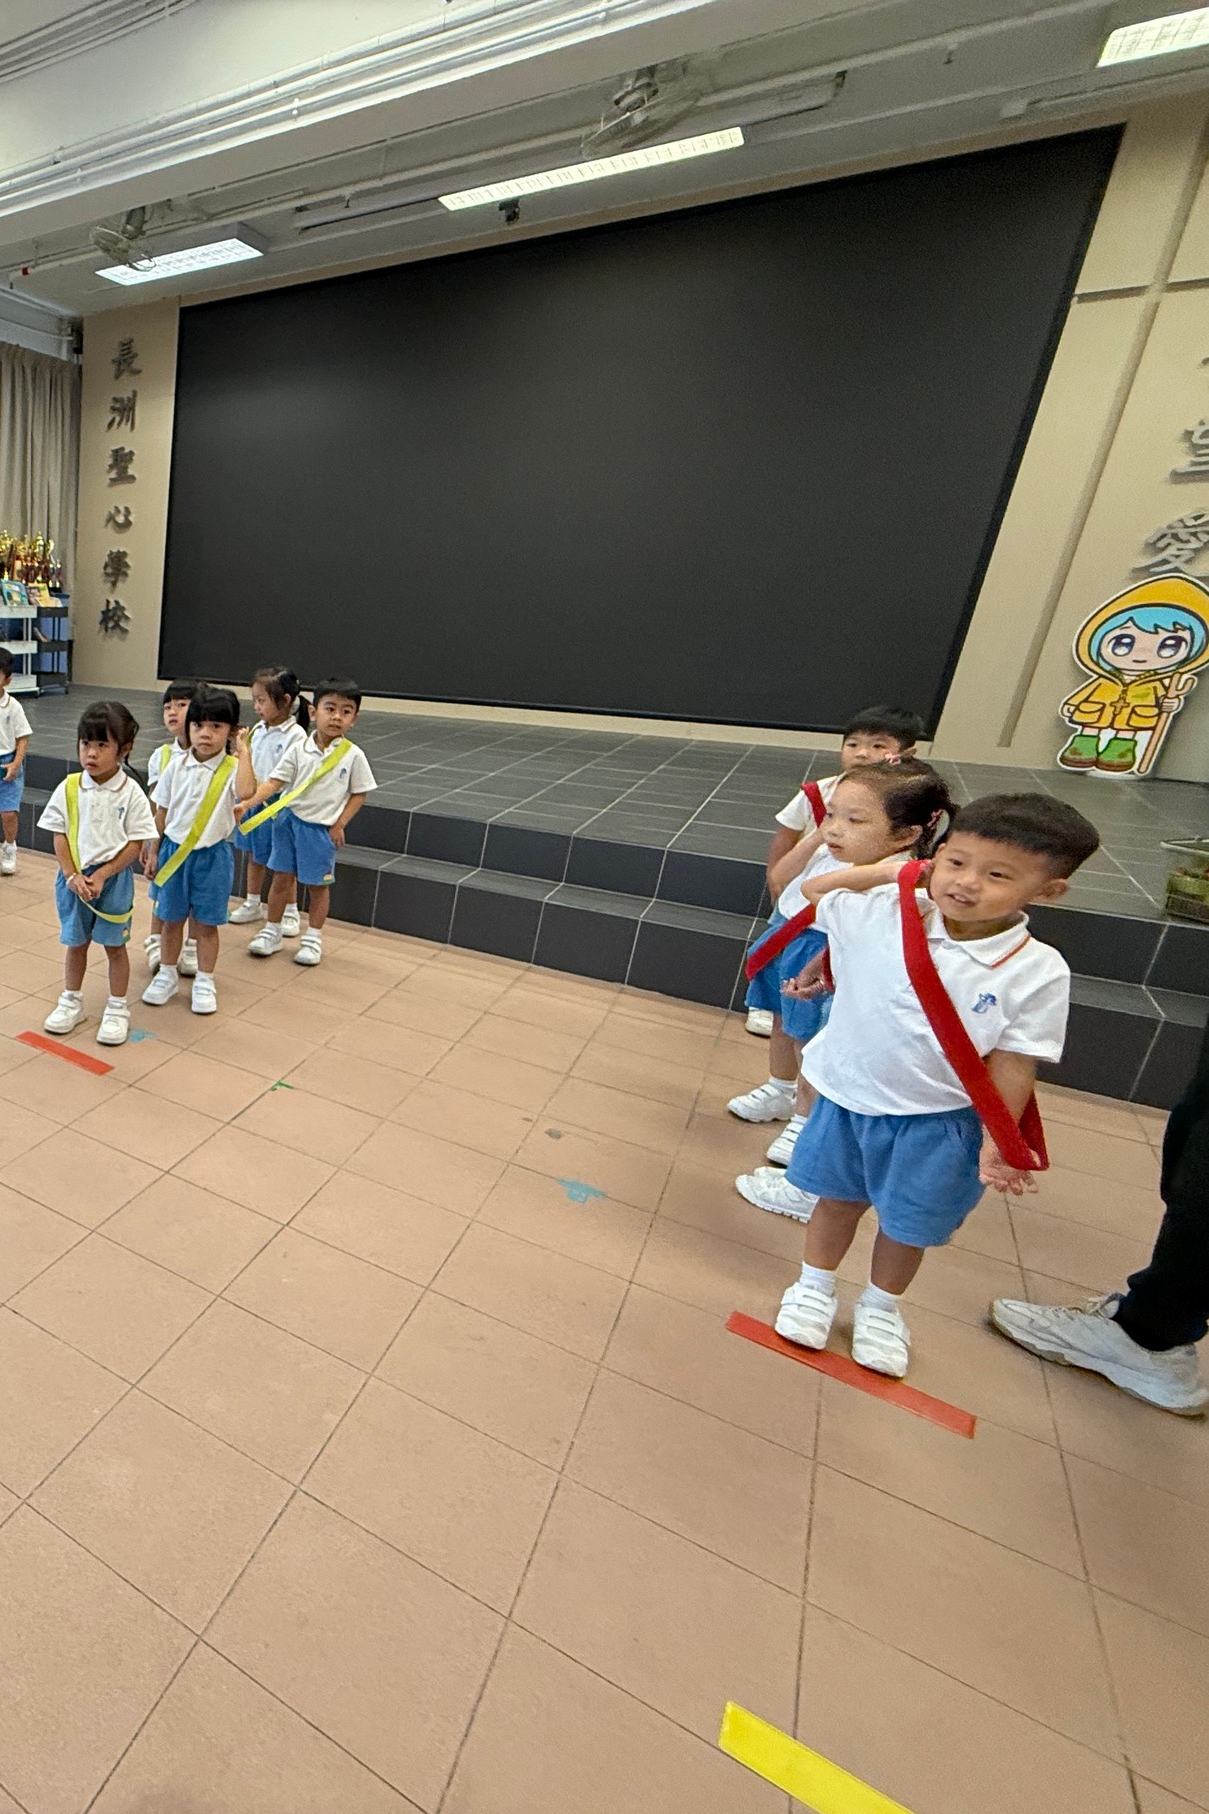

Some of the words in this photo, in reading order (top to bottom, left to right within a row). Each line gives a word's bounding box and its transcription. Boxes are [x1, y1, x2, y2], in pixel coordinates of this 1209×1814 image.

[99, 338, 142, 640] 長洲聖心學校
